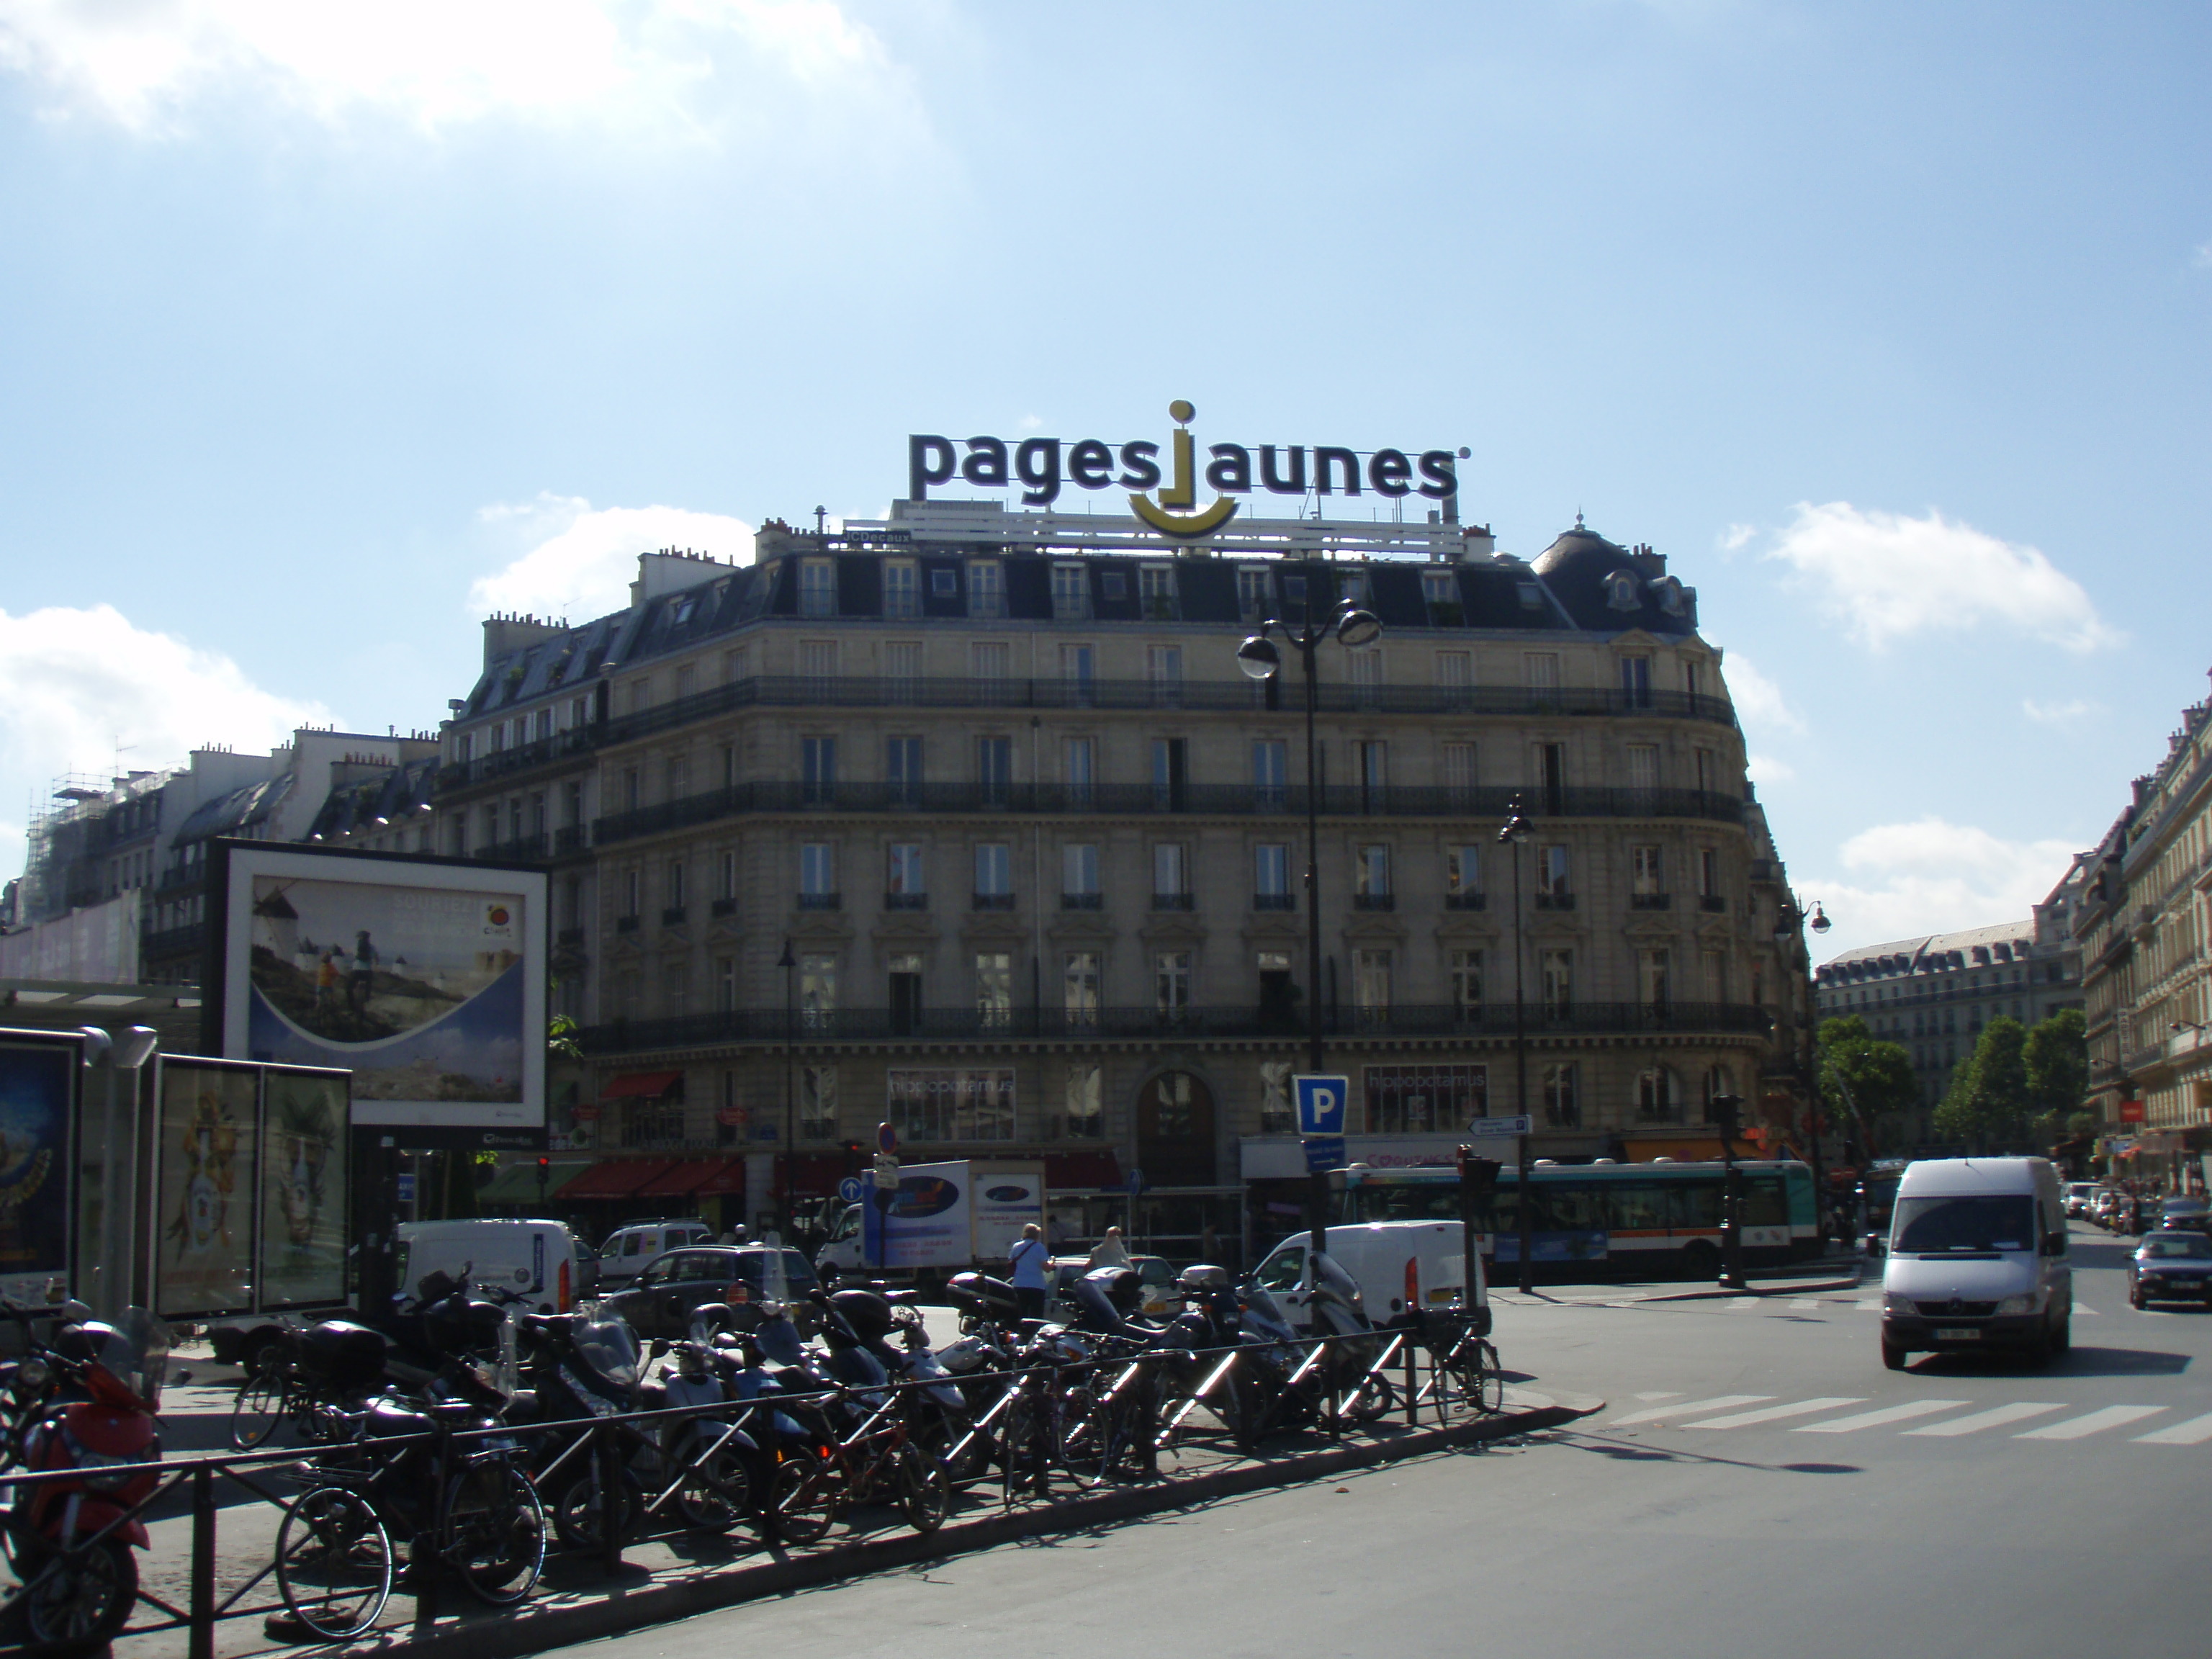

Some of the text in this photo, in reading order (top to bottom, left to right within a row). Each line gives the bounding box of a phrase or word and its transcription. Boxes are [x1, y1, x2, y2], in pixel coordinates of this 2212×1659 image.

[843, 532, 909, 542] JCDecaux
[889, 1076, 1014, 1097] hippopotamus
[1370, 1071, 1485, 1092] hippopotamus
[1312, 1088, 1335, 1123] P
